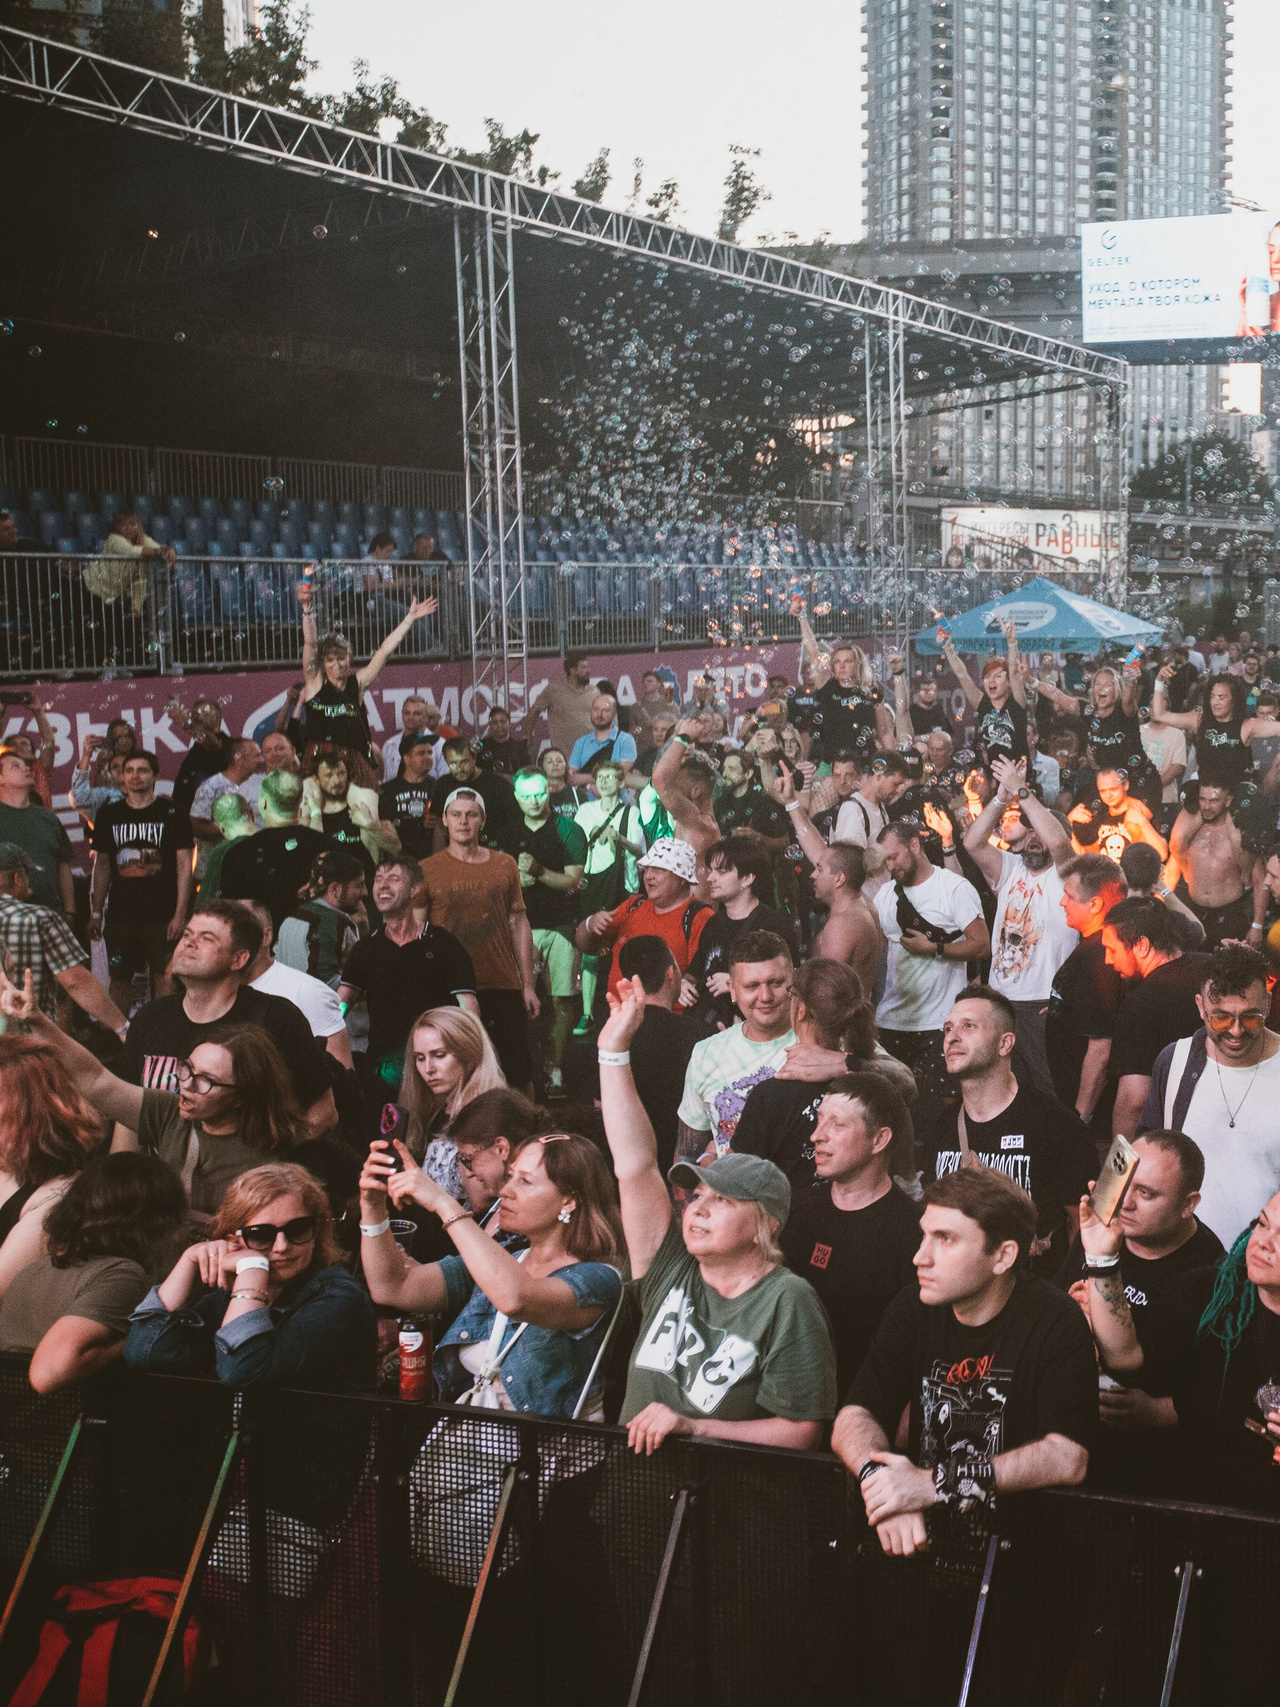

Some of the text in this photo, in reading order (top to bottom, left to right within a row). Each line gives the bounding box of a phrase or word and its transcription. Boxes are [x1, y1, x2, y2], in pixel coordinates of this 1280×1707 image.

[1088, 256, 1131, 267] GELTEK
[1129, 281, 1137, 291] О
[1141, 279, 1200, 291] КОТОРОМ
[1088, 294, 1221, 309] МЕЧТАЛА ТВОЯ КОЖА
[112, 822, 164, 848] WILD WEST
